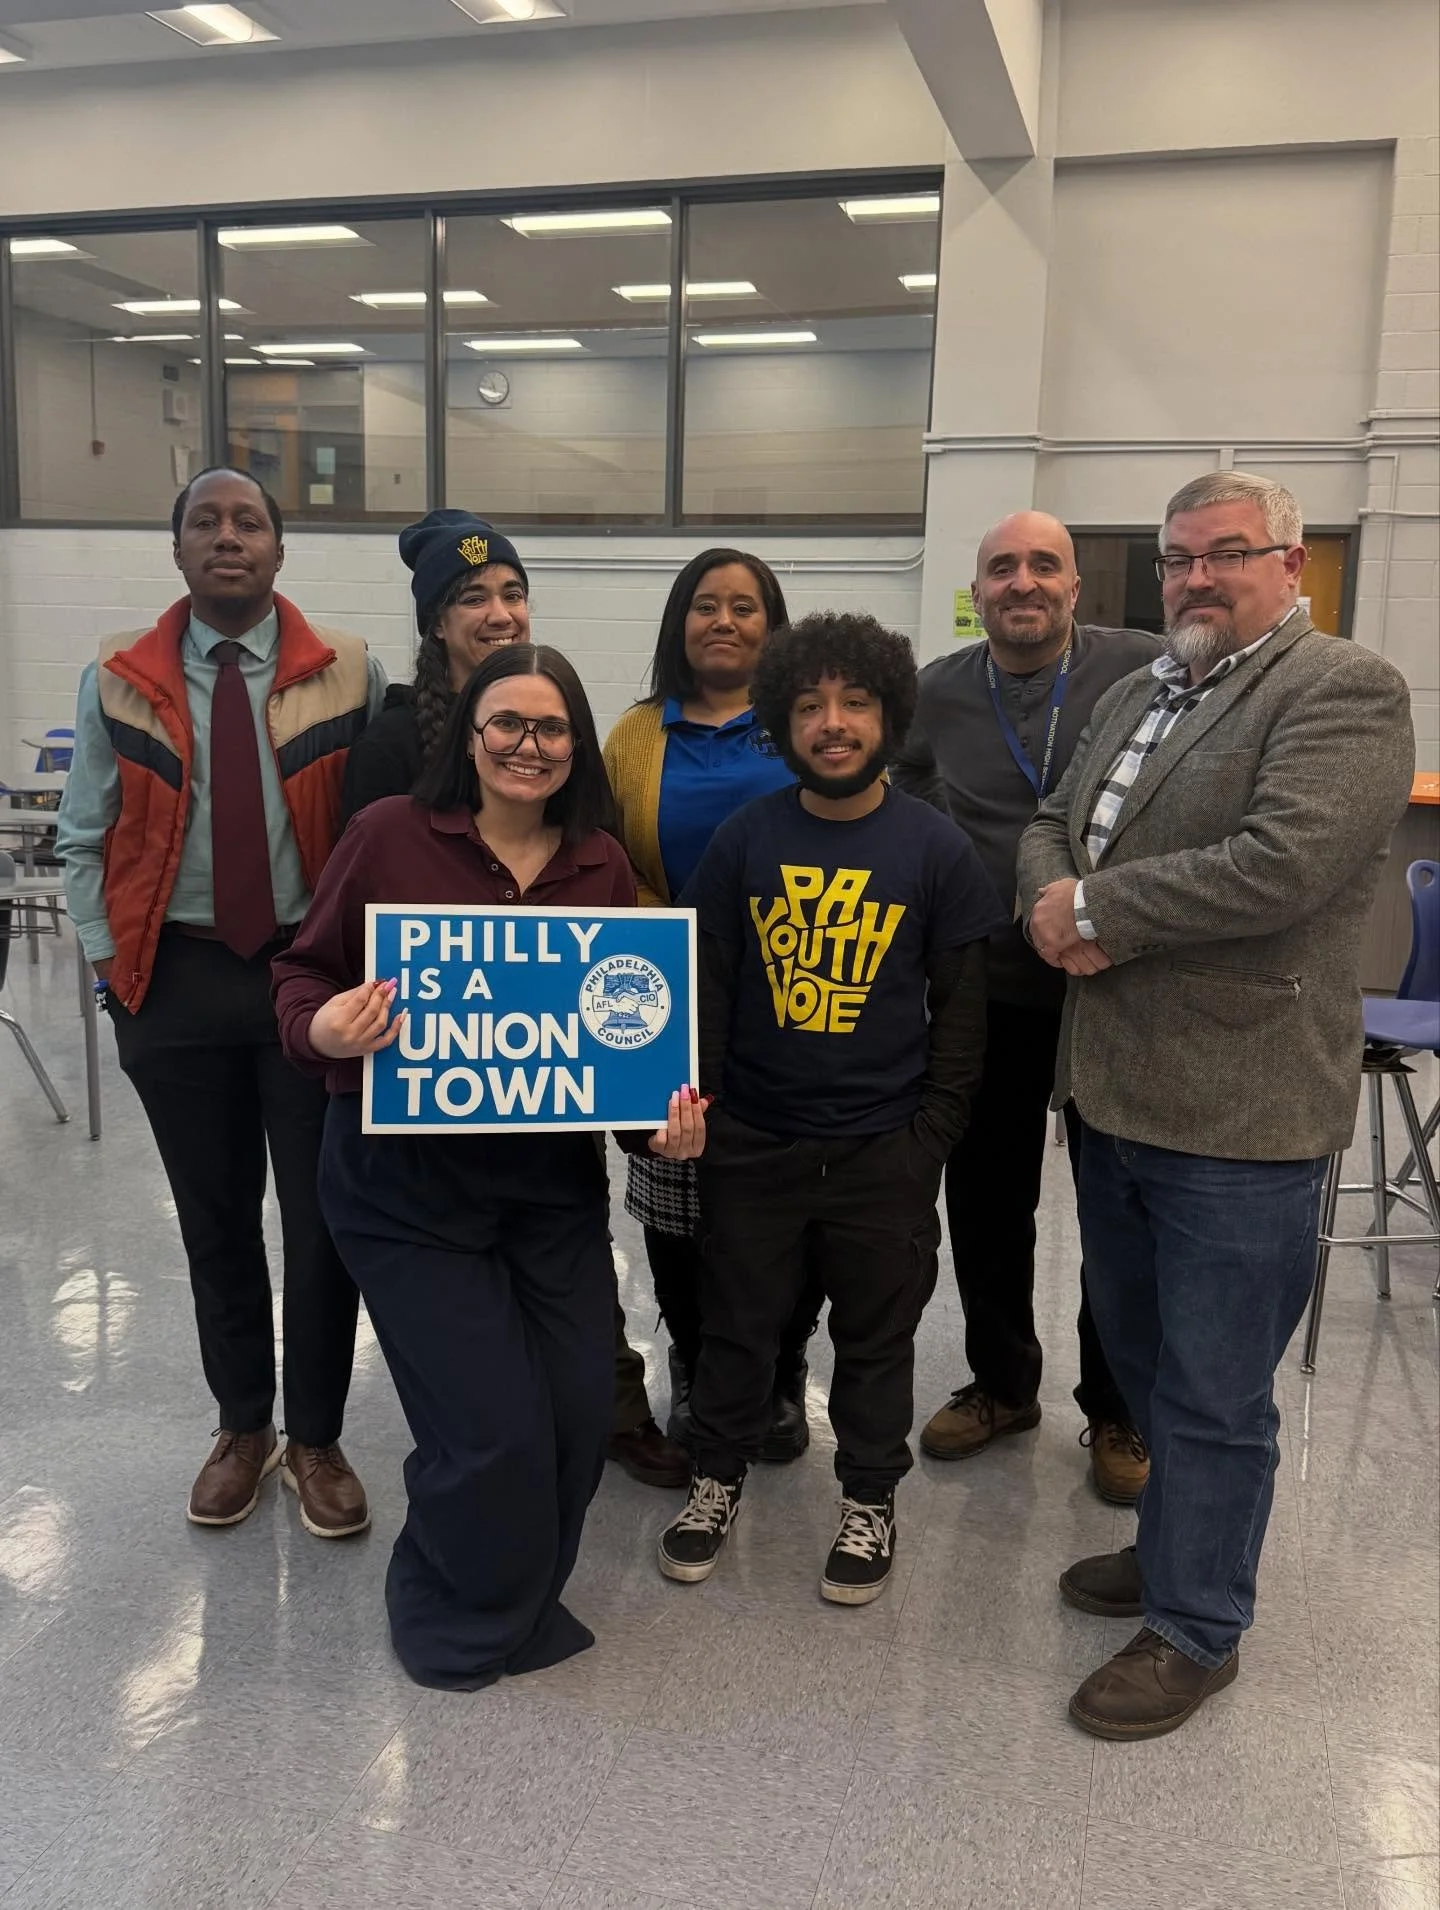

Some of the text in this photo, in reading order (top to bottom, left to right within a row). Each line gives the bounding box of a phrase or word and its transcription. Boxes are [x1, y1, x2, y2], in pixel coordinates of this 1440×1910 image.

[1060, 649, 1072, 675] SCHOOL
[1047, 706, 1060, 747] MOTIVATION
[1043, 748, 1053, 765] HIGH
[779, 864, 872, 929] PA
[400, 919, 603, 963] PHILLY
[749, 896, 907, 984] YOUTH
[400, 967, 493, 1000] IS A
[585, 959, 664, 993] PHILADELPHIA
[766, 956, 872, 1033] VOTE
[596, 1001, 613, 1010] AFL
[639, 993, 656, 1003] CIO
[398, 1012, 579, 1061] UNION
[597, 1027, 654, 1045] COUNCIL
[397, 1065, 595, 1117] TOWN
